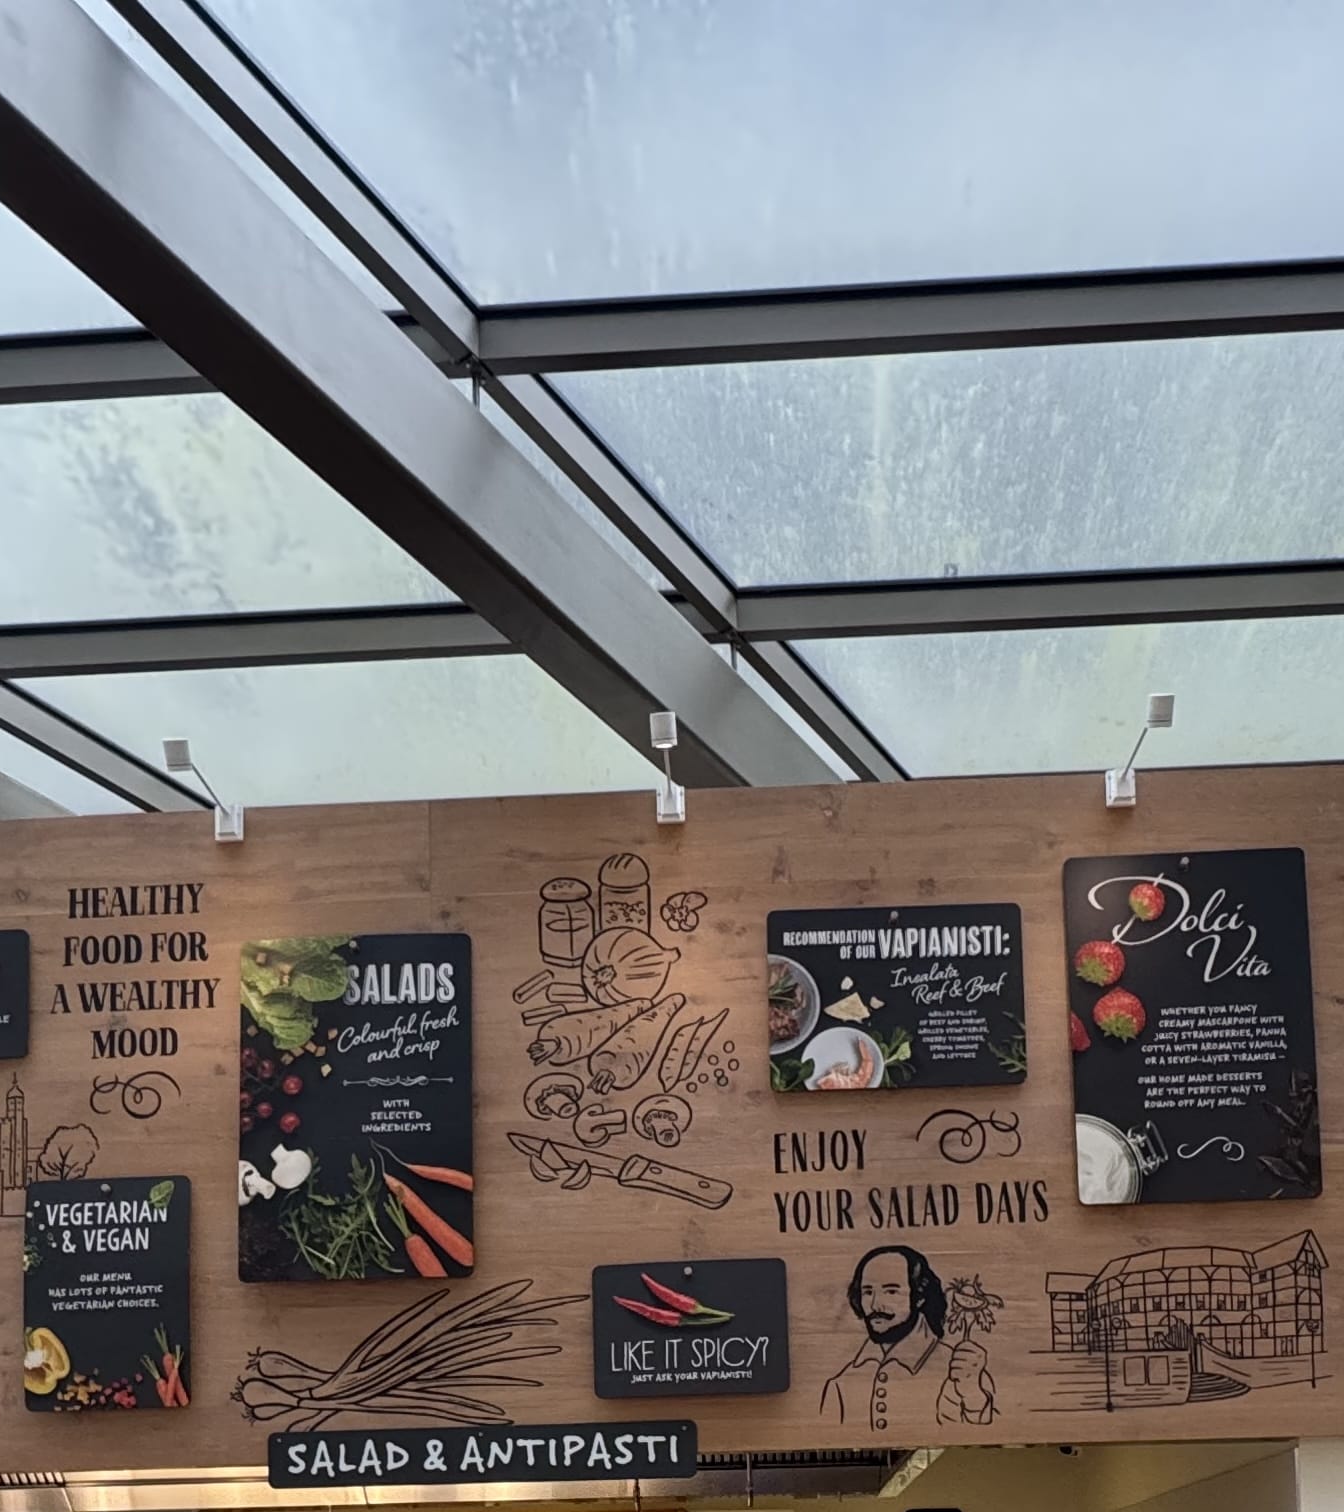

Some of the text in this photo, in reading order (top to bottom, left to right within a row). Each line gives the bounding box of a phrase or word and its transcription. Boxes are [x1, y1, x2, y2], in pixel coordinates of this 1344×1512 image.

[68, 883, 204, 919] HEALTHY
[1087, 872, 1245, 946] Dolci
[783, 929, 876, 947] RECOMMENDATION
[878, 925, 1010, 960] VAPIANISTI:
[62, 931, 209, 967] FOOD FOR
[840, 945, 876, 960] OF OUR
[1185, 925, 1273, 983] Vita
[343, 962, 456, 1005] SALADS
[911, 972, 1008, 1005] Reef & Beef
[50, 978, 221, 1014] A WEALTHY
[1160, 1004, 1258, 1016] WHETHER YOU FANCY
[420, 1005, 459, 1040] fresh
[1158, 1016, 1284, 1029] CREAMY MASCARPONE WITH
[90, 1027, 179, 1059] MOOD
[1153, 1027, 1287, 1042] JUICY STRAWBERRIES, PANNA
[367, 1037, 440, 1063] and crisp
[1141, 1039, 1288, 1053] COTTA WITH AROMATIC VANILLA,
[1144, 1052, 1276, 1065] OR A SEVEN-LAYER TIRAMISU
[1137, 1072, 1263, 1084] OUR HOME MADE DESSERTS
[1146, 1084, 1267, 1097] ARE THE PERFECT WAY TO
[383, 1099, 410, 1109] WITH
[1144, 1100, 1175, 1109] ROUND
[1178, 1099, 1195, 1108] OFF
[1197, 1098, 1216, 1109] ANY
[371, 1111, 423, 1121] SELECTED
[361, 1123, 432, 1133] INGREDIENTS
[773, 1129, 867, 1174] ENJOY
[45, 1201, 168, 1226] VEGETARIAN
[774, 1179, 1049, 1233] YOUR SALAD DAYS
[62, 1227, 150, 1254] & VEGAN
[79, 1272, 132, 1282] OUR MENU
[48, 1284, 164, 1298] HAS LOTS OF FANTASTIC
[51, 1300, 115, 1311] VEGETARIAN
[611, 1336, 769, 1373] LIKE IT SPICY?
[631, 1374, 653, 1384] JUST
[656, 1373, 673, 1383] ASK
[675, 1371, 698, 1384] YOUR
[287, 1432, 679, 1478] SALAD & ANTIPASTI
